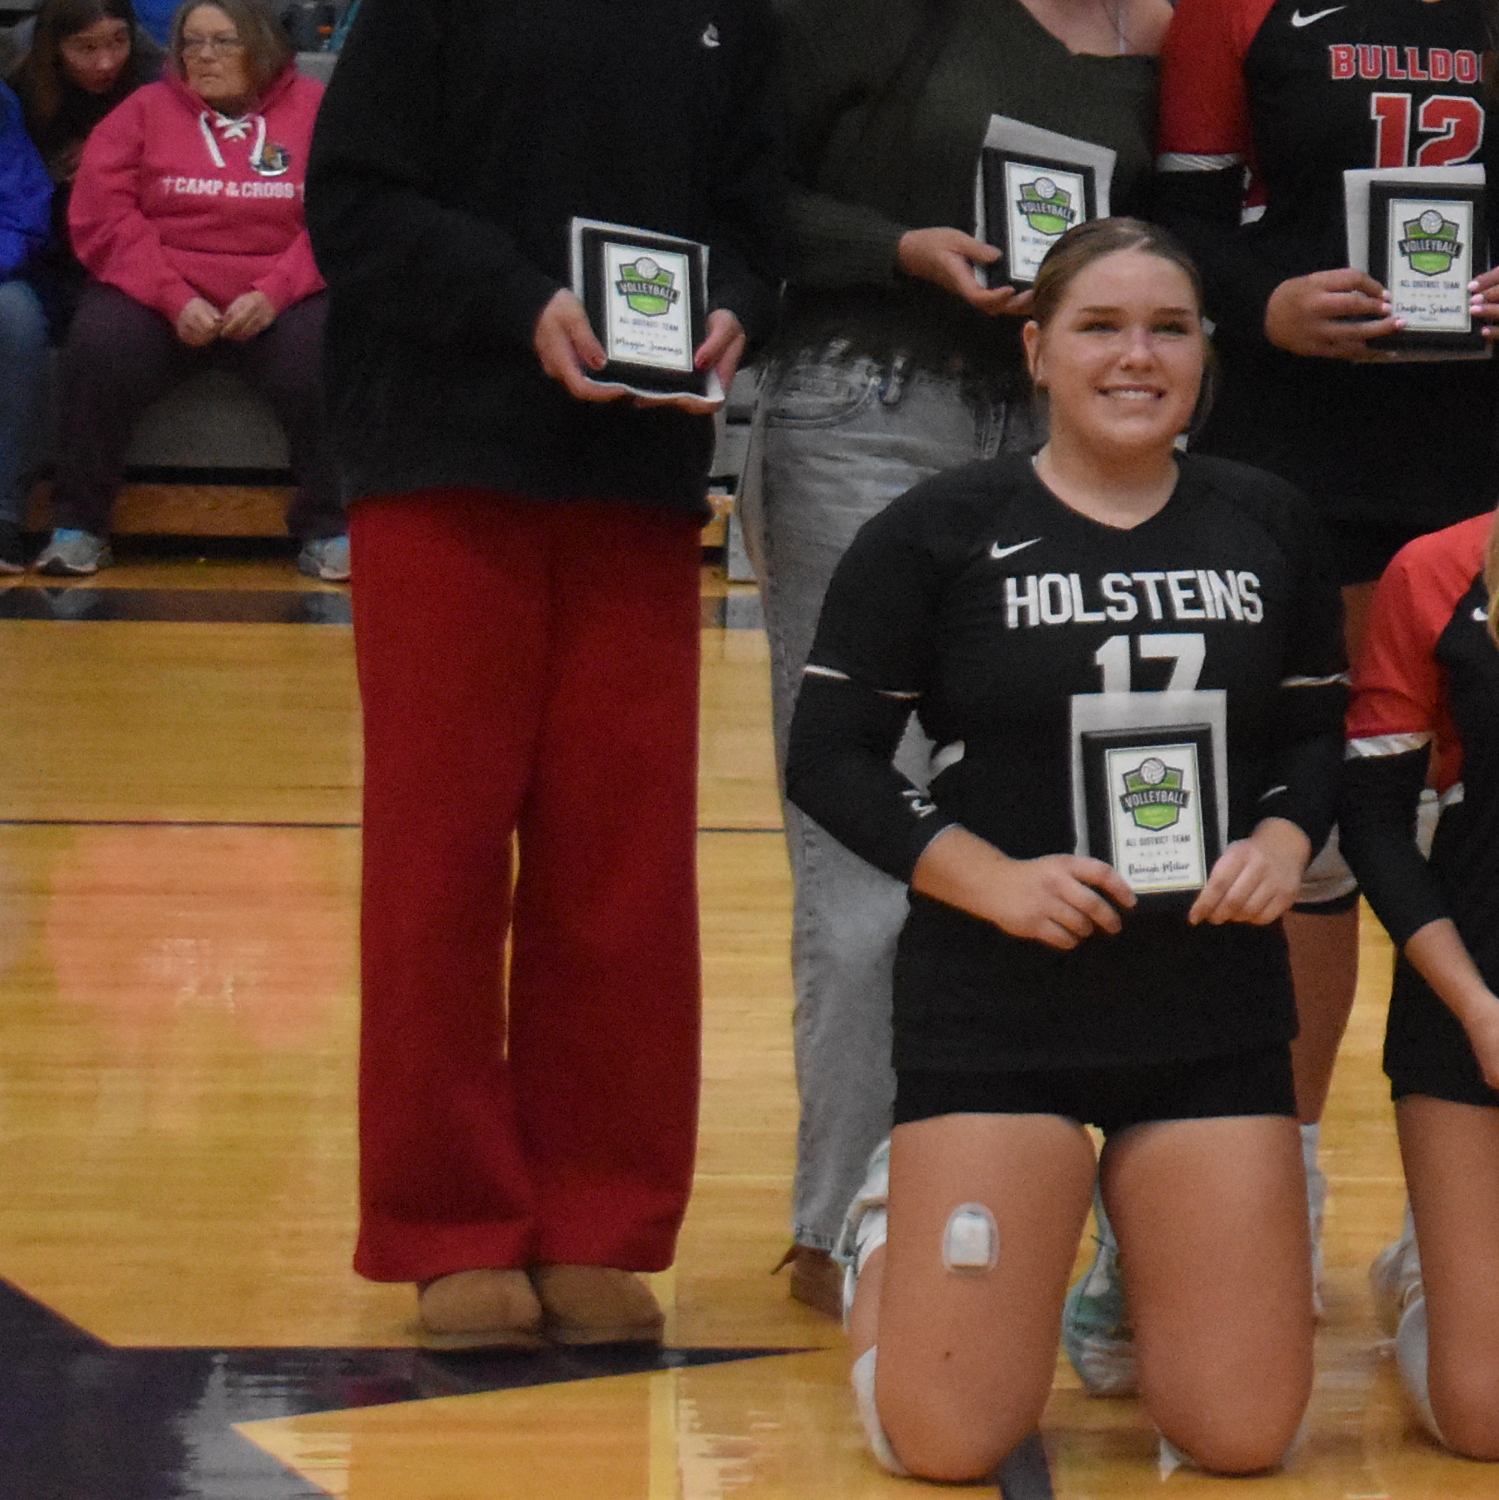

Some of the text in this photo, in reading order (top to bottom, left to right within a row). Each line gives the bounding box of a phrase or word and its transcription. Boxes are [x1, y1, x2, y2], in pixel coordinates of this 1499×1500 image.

[1371, 92, 1485, 167] 12
[175, 176, 294, 200] CAMP & CROSS
[1021, 200, 1074, 221] VOLLEYBALL
[1403, 239, 1458, 255] VOLLEYBALL
[620, 281, 676, 299] VOLLEYBALL
[1005, 569, 1264, 629] HOLSTEINS
[1095, 632, 1207, 692] 17
[1124, 790, 1184, 808] VOLLEYBALL
